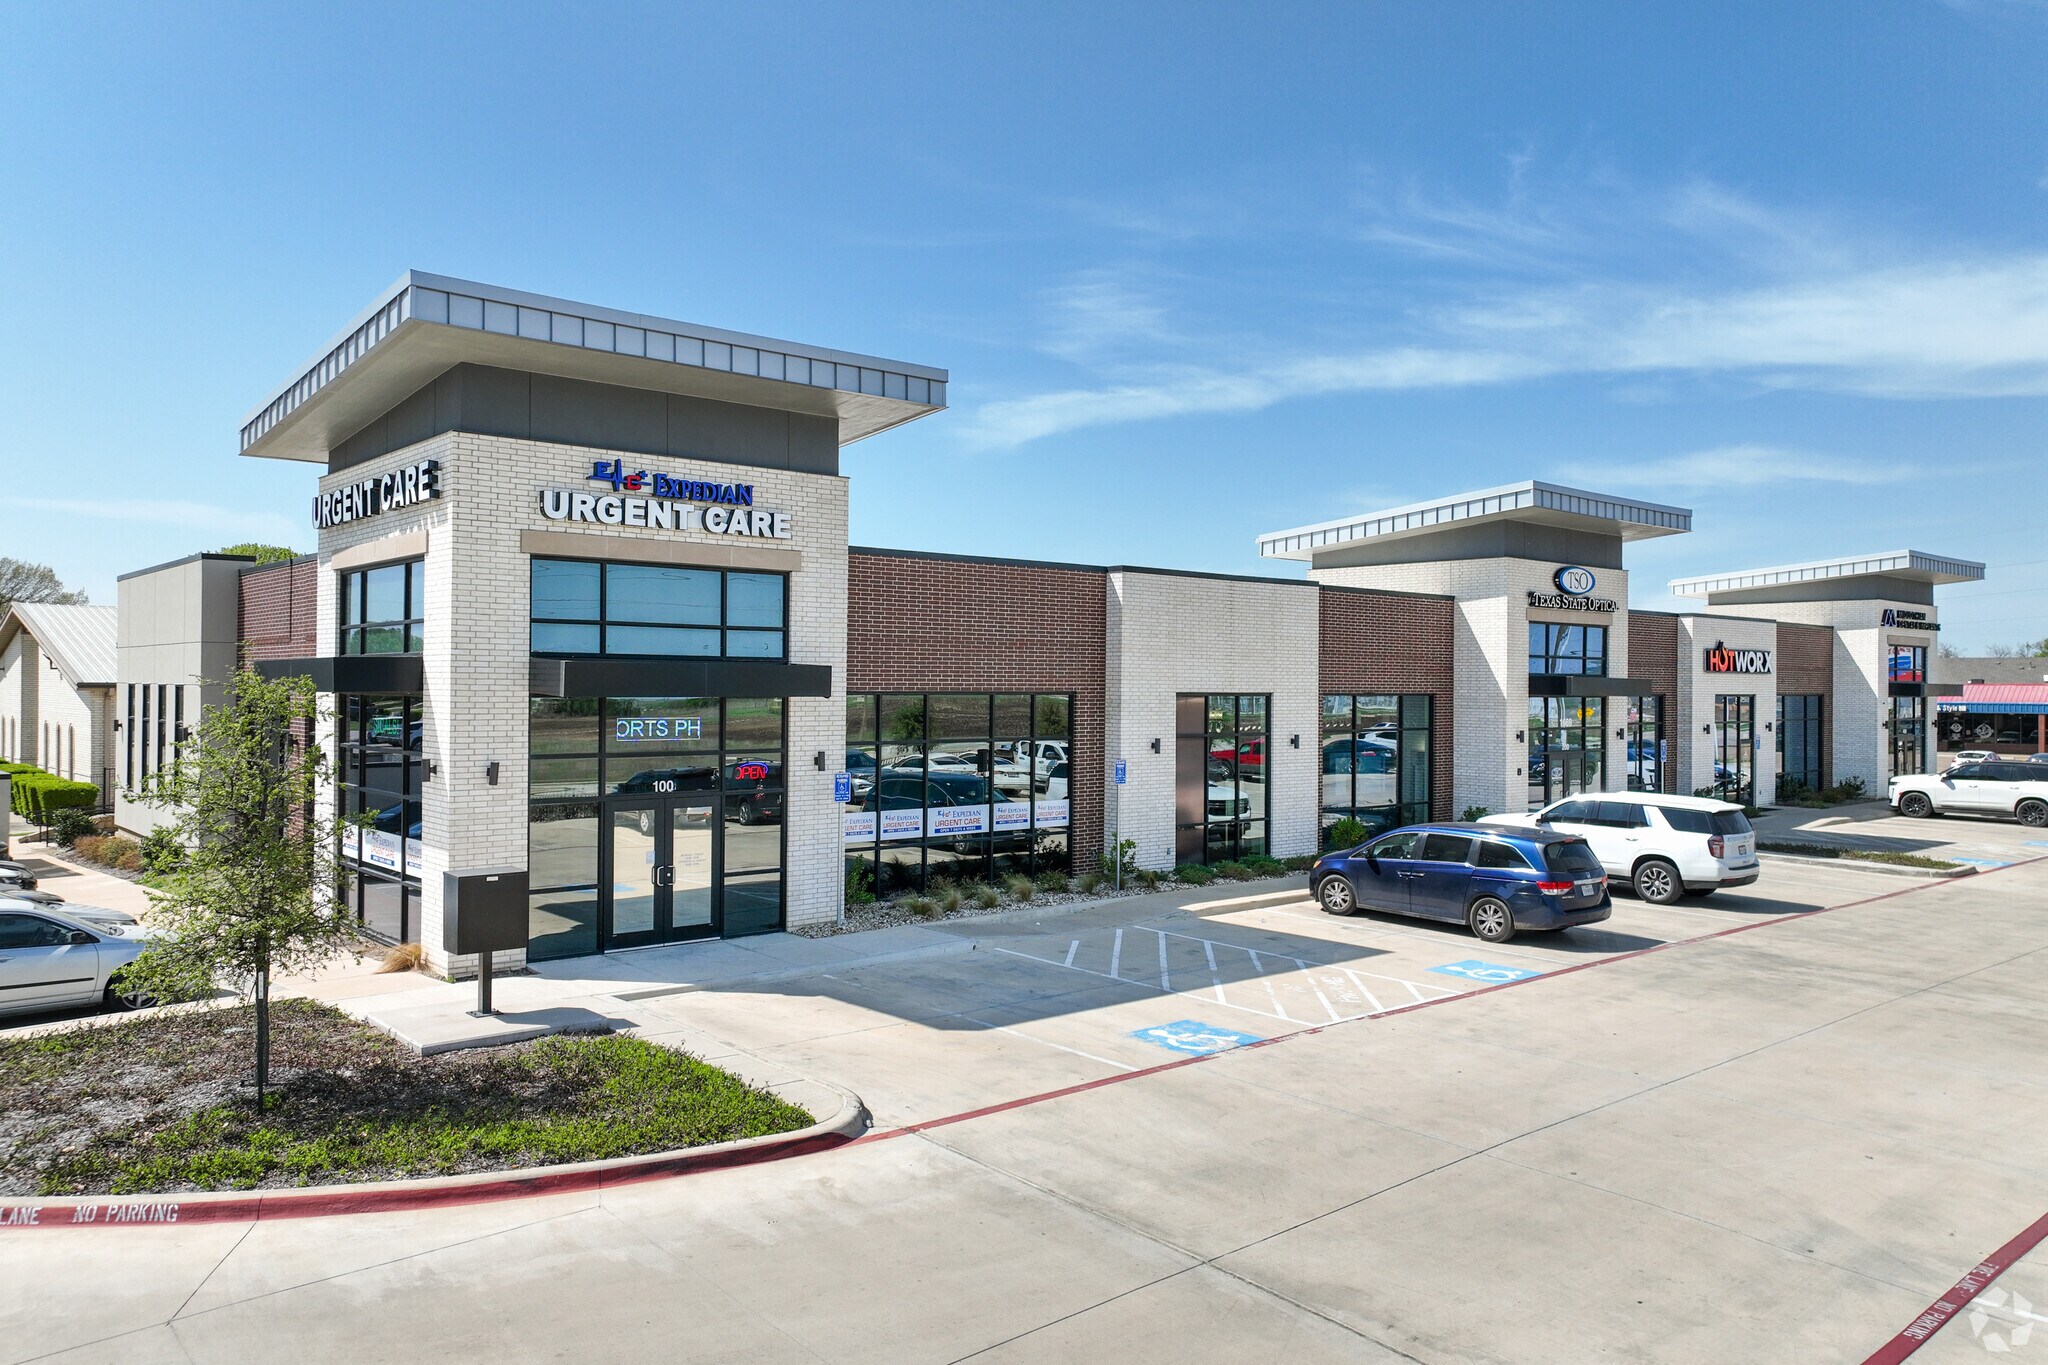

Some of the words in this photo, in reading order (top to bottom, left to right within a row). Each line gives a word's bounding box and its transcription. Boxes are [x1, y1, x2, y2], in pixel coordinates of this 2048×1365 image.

[312, 479, 376, 530] URGENT
[381, 460, 435, 511] CARE
[653, 473, 754, 506] EXPEDIAN
[540, 490, 695, 530] URGENT
[703, 507, 792, 539] CARE
[1567, 572, 1589, 590] TSO
[1533, 593, 1561, 608] TEXAS
[1562, 595, 1588, 611] STATE
[1710, 645, 1773, 673] HOTWORX
[617, 720, 668, 737] ORTS
[675, 720, 700, 736] PH
[735, 766, 767, 780] OPEN
[653, 780, 675, 792] 100
[935, 819, 963, 828] URGENT
[964, 818, 982, 826] CARE
[953, 810, 982, 818] EXPEDIAN
[0, 1206, 43, 1225] LANE
[72, 1205, 98, 1223] NO
[105, 1204, 179, 1222] PARKING
[1902, 1310, 1947, 1339] PARKING
